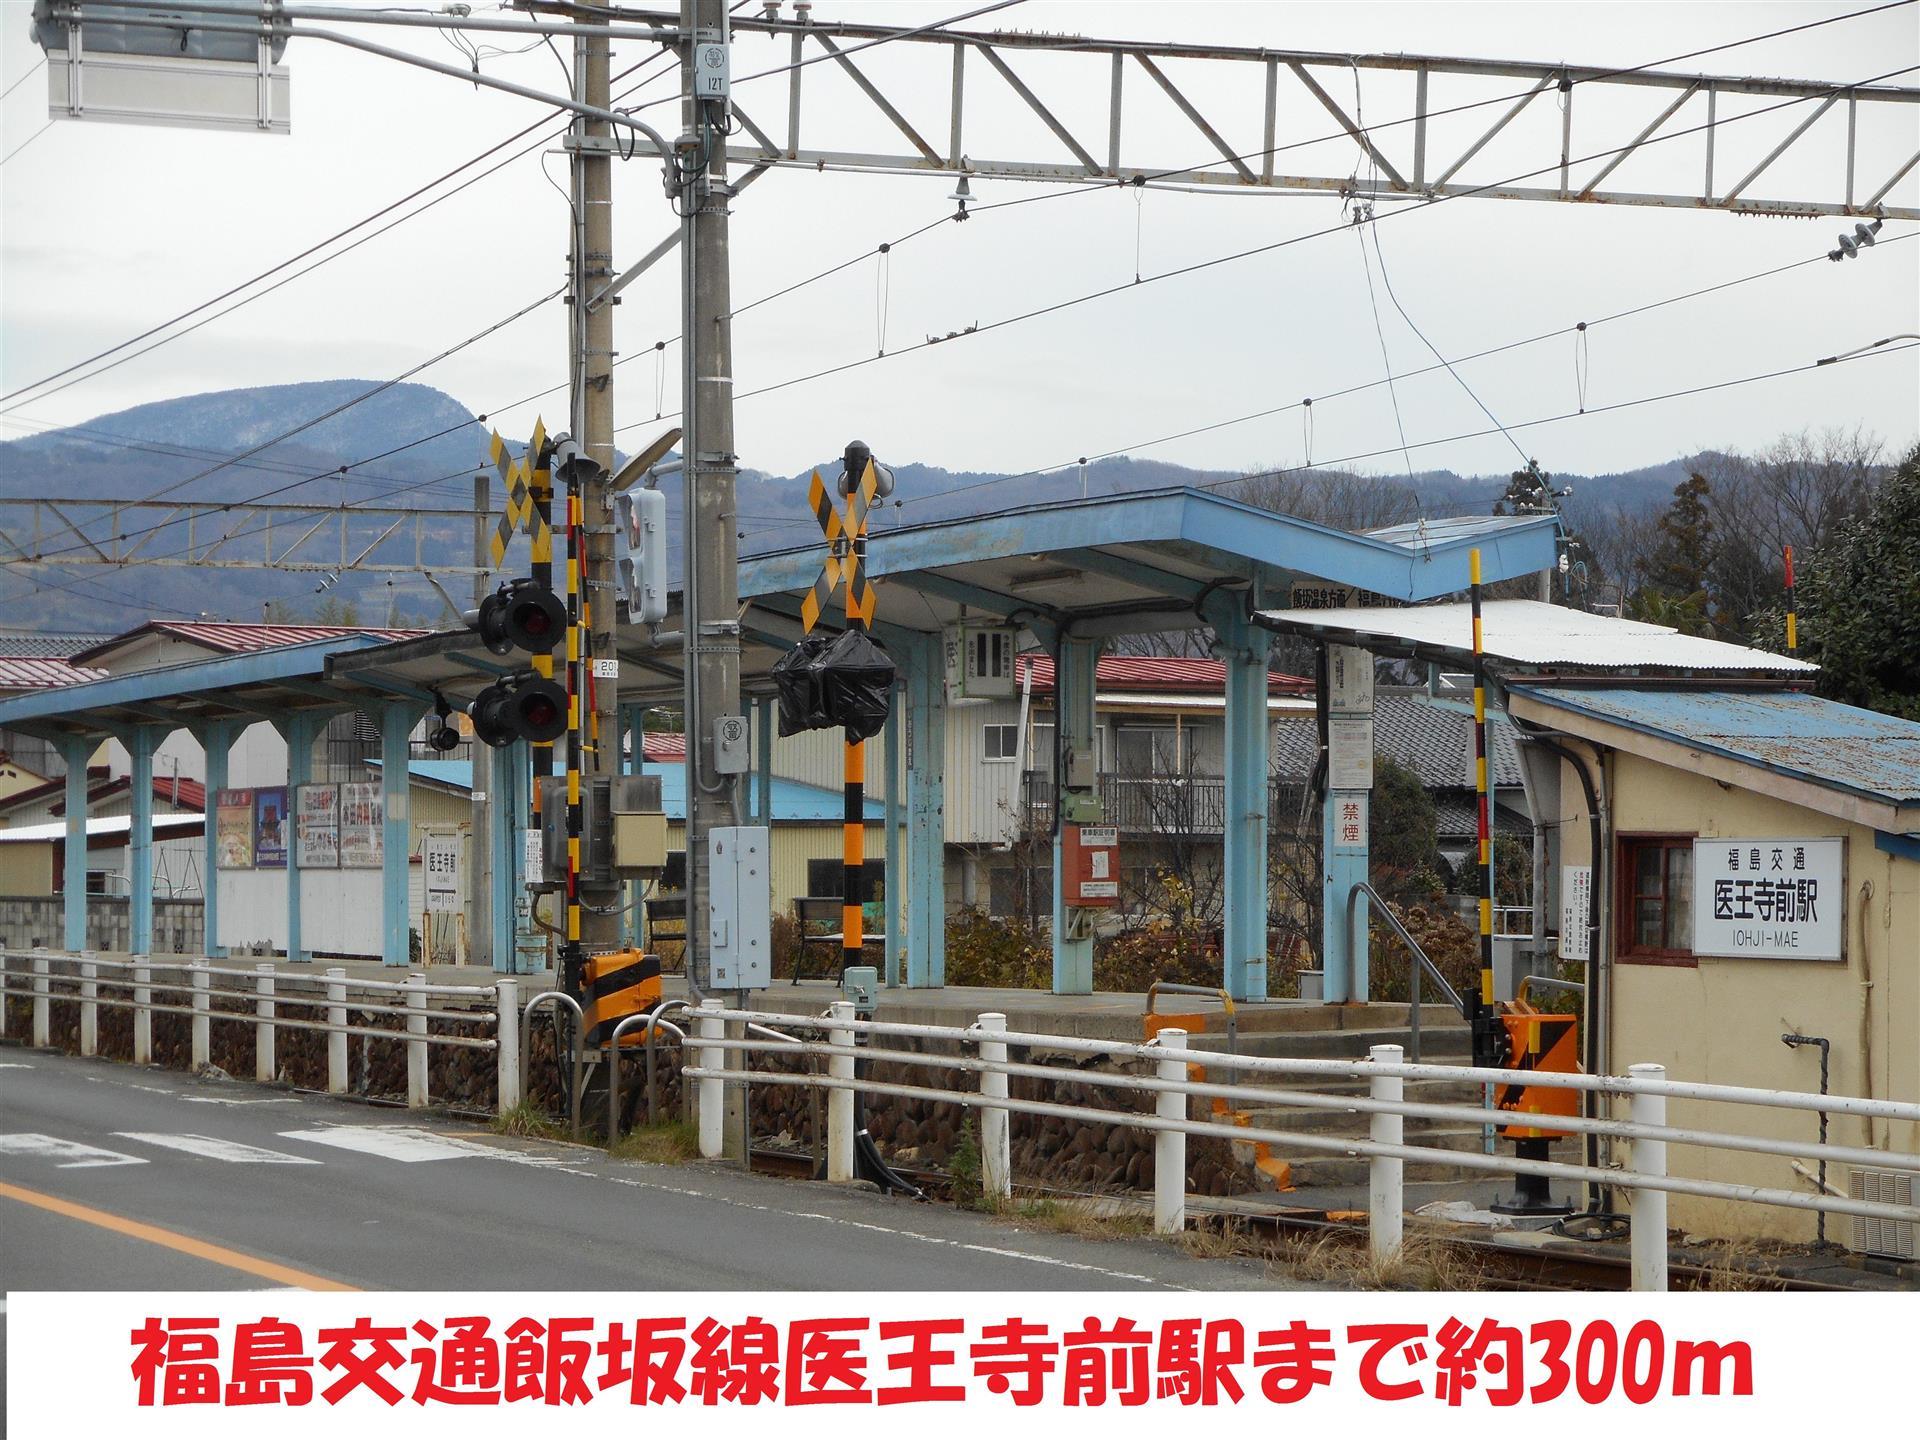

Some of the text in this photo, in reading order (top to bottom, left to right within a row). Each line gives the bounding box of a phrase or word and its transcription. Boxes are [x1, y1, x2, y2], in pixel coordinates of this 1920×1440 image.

[708, 77, 723, 91] 12T
[1342, 802, 1359, 842] 禁煙
[429, 852, 456, 873] 医王寺前
[1727, 847, 1806, 871] 福島交通
[1714, 877, 1818, 923] 医王寺前駅
[1732, 929, 1799, 948] IOHJI-MAE
